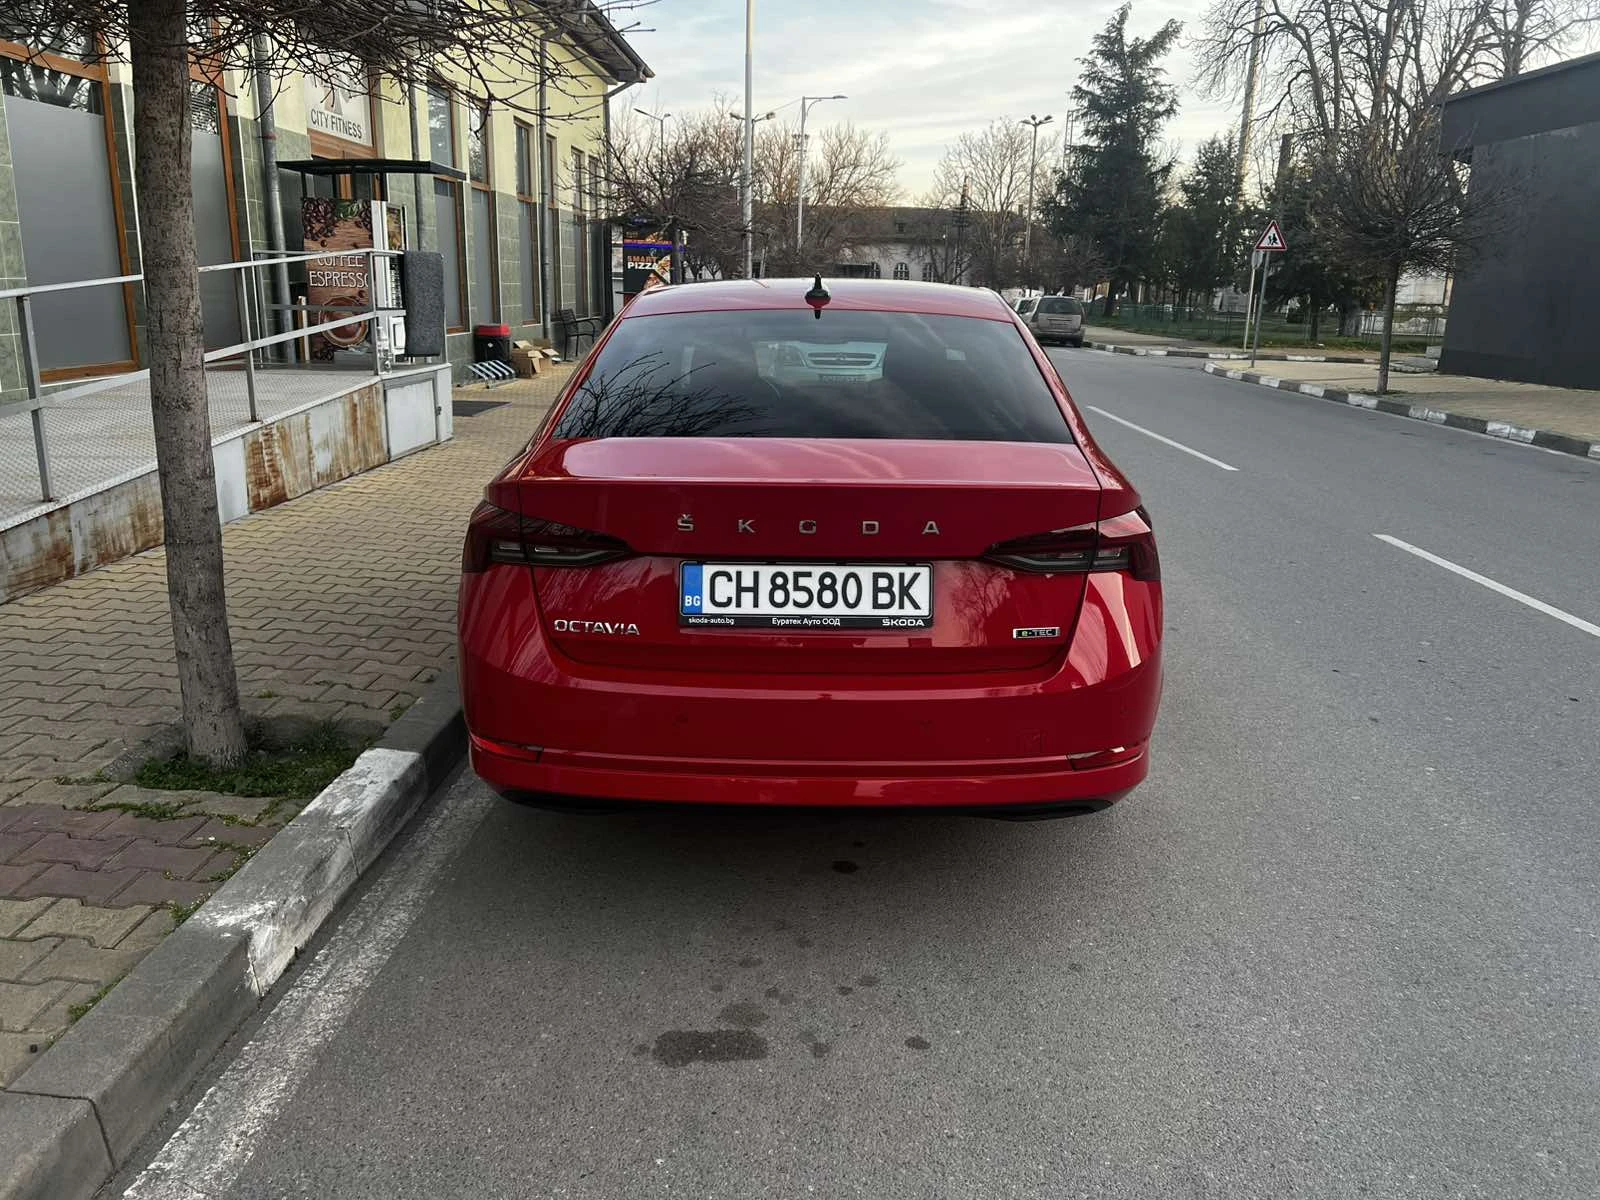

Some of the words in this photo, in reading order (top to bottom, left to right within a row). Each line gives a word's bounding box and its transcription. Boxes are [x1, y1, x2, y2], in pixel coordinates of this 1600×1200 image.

[311, 108, 328, 128] CITY
[331, 115, 362, 139] FITNESS
[677, 514, 940, 535] ŠKODA
[709, 570, 759, 608] CH
[768, 571, 863, 609] 8580
[872, 572, 922, 610] BK
[684, 595, 700, 607] BG
[554, 619, 640, 636] OCTAVIA
[688, 617, 734, 625] skoda-auto.bg
[802, 618, 820, 626] Ауто
